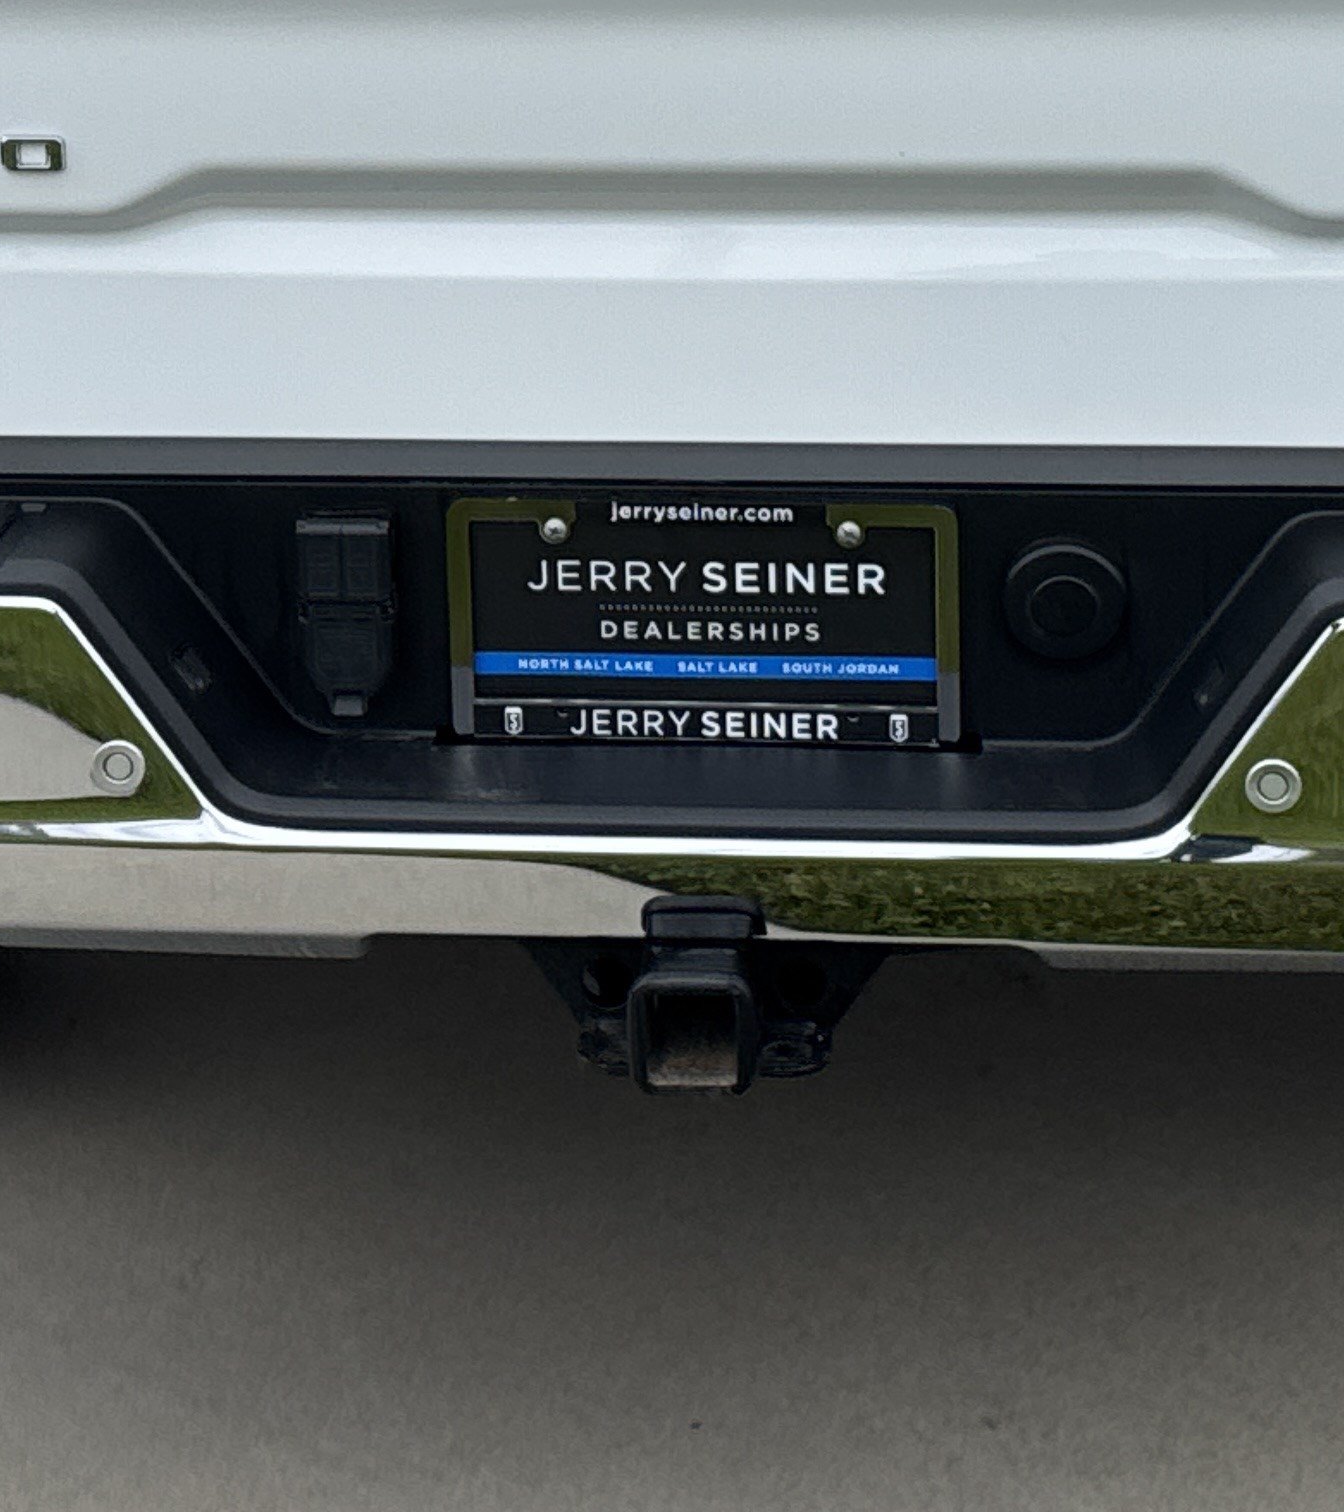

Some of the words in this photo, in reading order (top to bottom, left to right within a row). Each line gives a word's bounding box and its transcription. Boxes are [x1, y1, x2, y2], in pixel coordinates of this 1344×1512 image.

[610, 501, 794, 524] jerryseiner.com
[526, 559, 687, 594] JERRY
[702, 561, 886, 596] SEINER
[600, 619, 821, 643] DEALERSHIPS
[517, 658, 569, 671] NORTH
[573, 658, 609, 671] SALT
[614, 660, 654, 672] LAKE
[677, 661, 714, 673] SALT
[718, 662, 758, 674] LAKE
[782, 663, 833, 675] SOUTH
[837, 663, 899, 676] JORDAN
[570, 708, 690, 736] JERRY
[701, 710, 839, 740] SEINER
